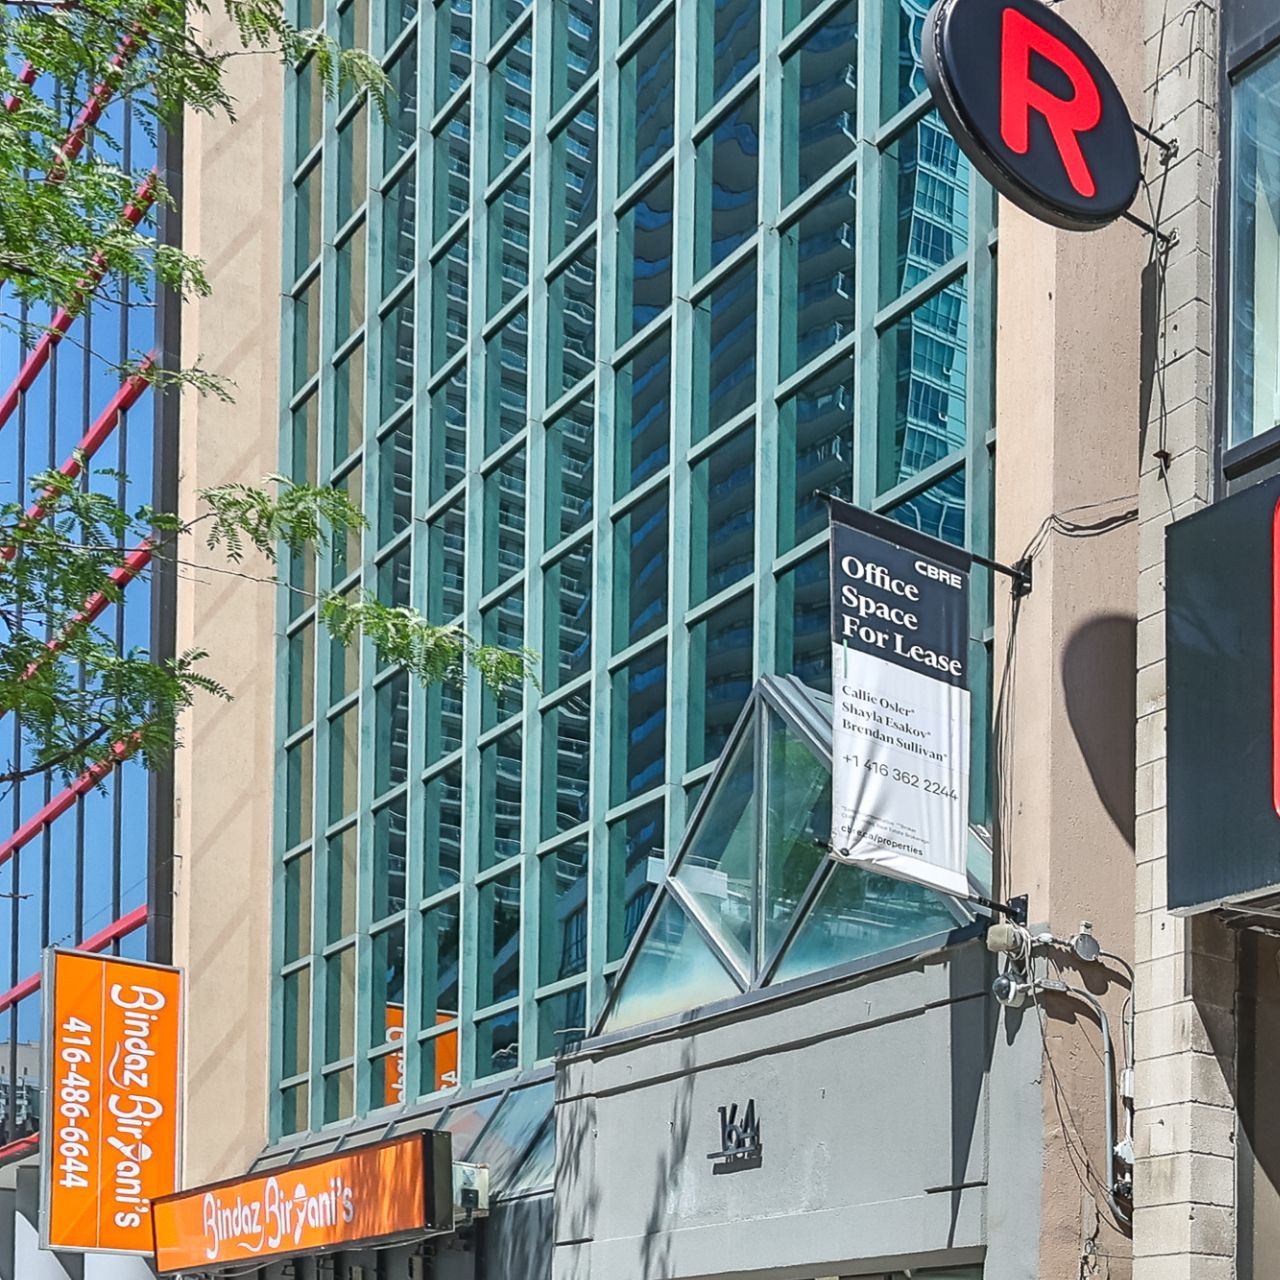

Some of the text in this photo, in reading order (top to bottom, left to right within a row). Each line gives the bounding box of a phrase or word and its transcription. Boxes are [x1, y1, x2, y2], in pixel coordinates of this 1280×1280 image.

[1001, 7, 1101, 198] R
[841, 555, 919, 602] Office
[914, 560, 962, 589] CBRE
[842, 585, 918, 631] Space
[842, 613, 962, 676] For Lease
[842, 685, 878, 704] Callie
[842, 702, 883, 724] Shayla
[842, 719, 894, 745] Brendan
[842, 755, 958, 800] +1 416 362 2244
[107, 983, 166, 1091] Bindaz
[59, 1016, 92, 1188] 416-486-6644
[717, 1098, 761, 1153] 164
[106, 1093, 163, 1228] Biryani's
[203, 1191, 265, 1260] Bindaz
[265, 1174, 353, 1249] Biryani's
